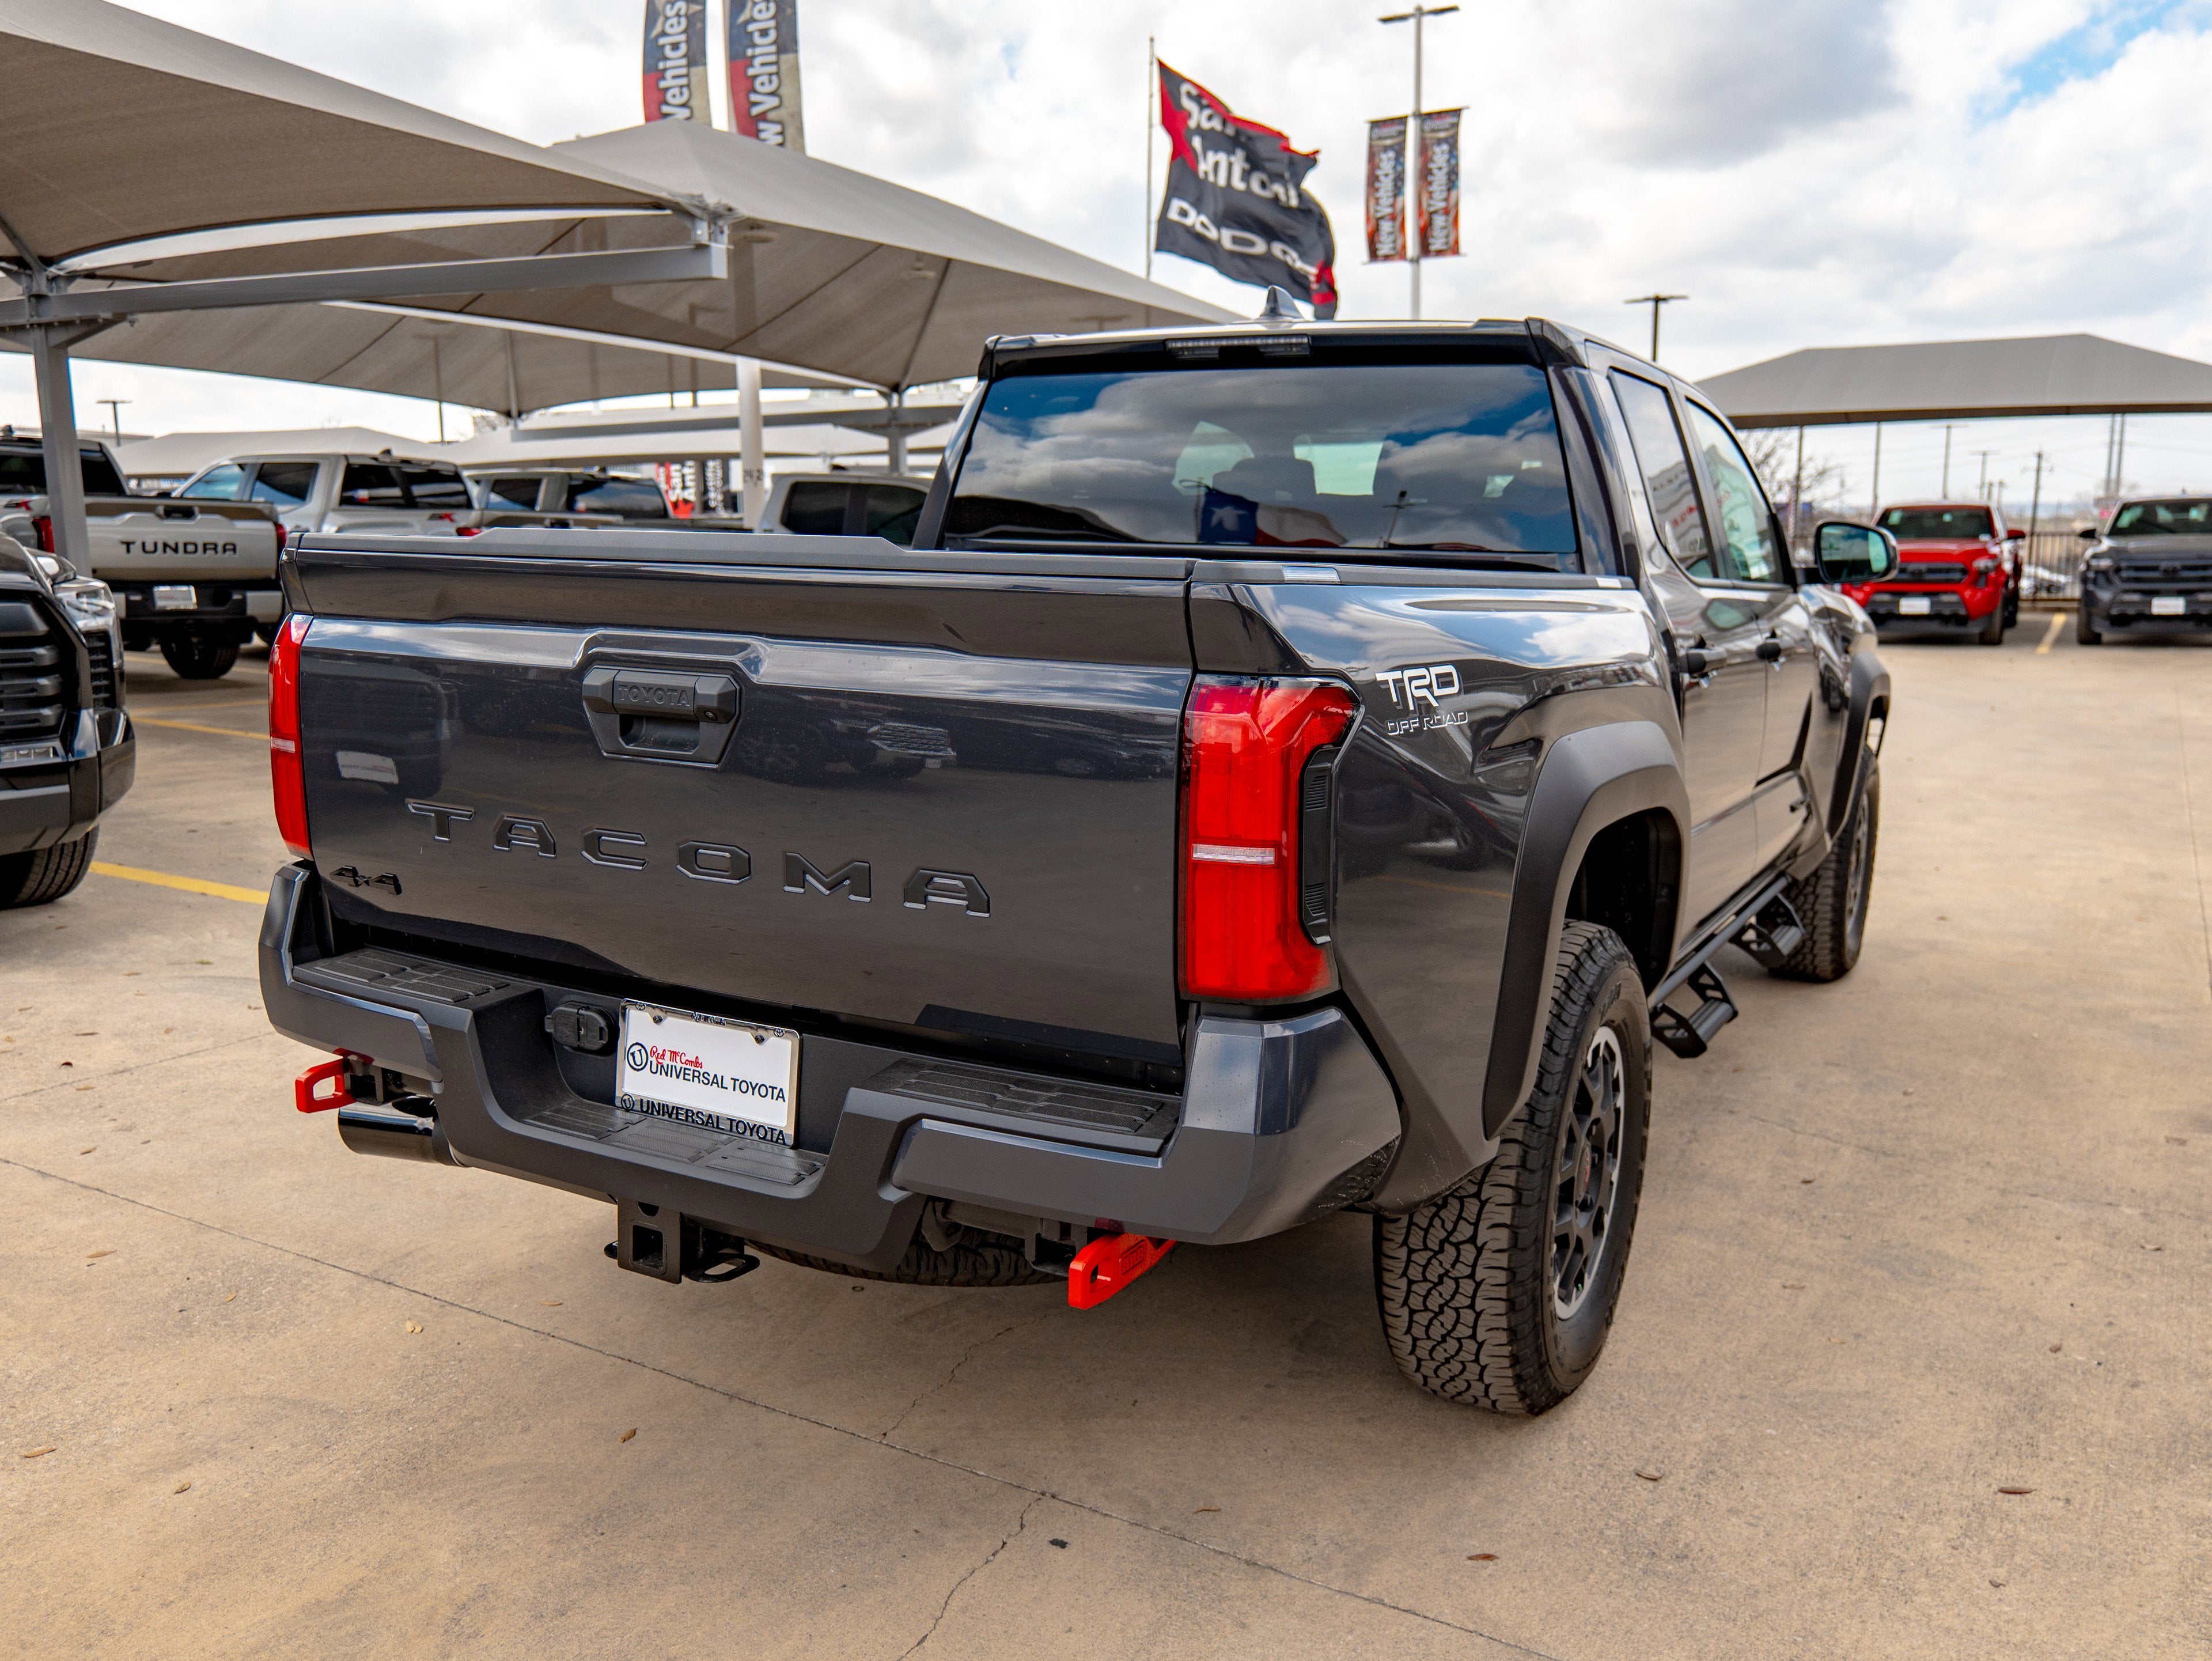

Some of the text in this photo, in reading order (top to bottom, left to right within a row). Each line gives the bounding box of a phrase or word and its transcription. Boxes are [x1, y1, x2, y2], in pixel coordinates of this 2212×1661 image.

[746, 0, 782, 116] Vehicle
[1373, 149, 1396, 220] Vehicles
[1427, 143, 1450, 214] Vehicles
[1375, 220, 1398, 256] New
[1428, 214, 1450, 251] New
[120, 540, 237, 555] TUNDRA
[618, 684, 691, 706] TOYOTA
[1374, 664, 1460, 710] TRD
[1385, 711, 1468, 736] OFF ROAD
[407, 799, 991, 918] TACOMA
[649, 1045, 703, 1069] Red McCombs
[649, 1060, 786, 1103] UNIVERSAL TOYOTA
[639, 1098, 787, 1145] UNIVERSAL TOYOTA
